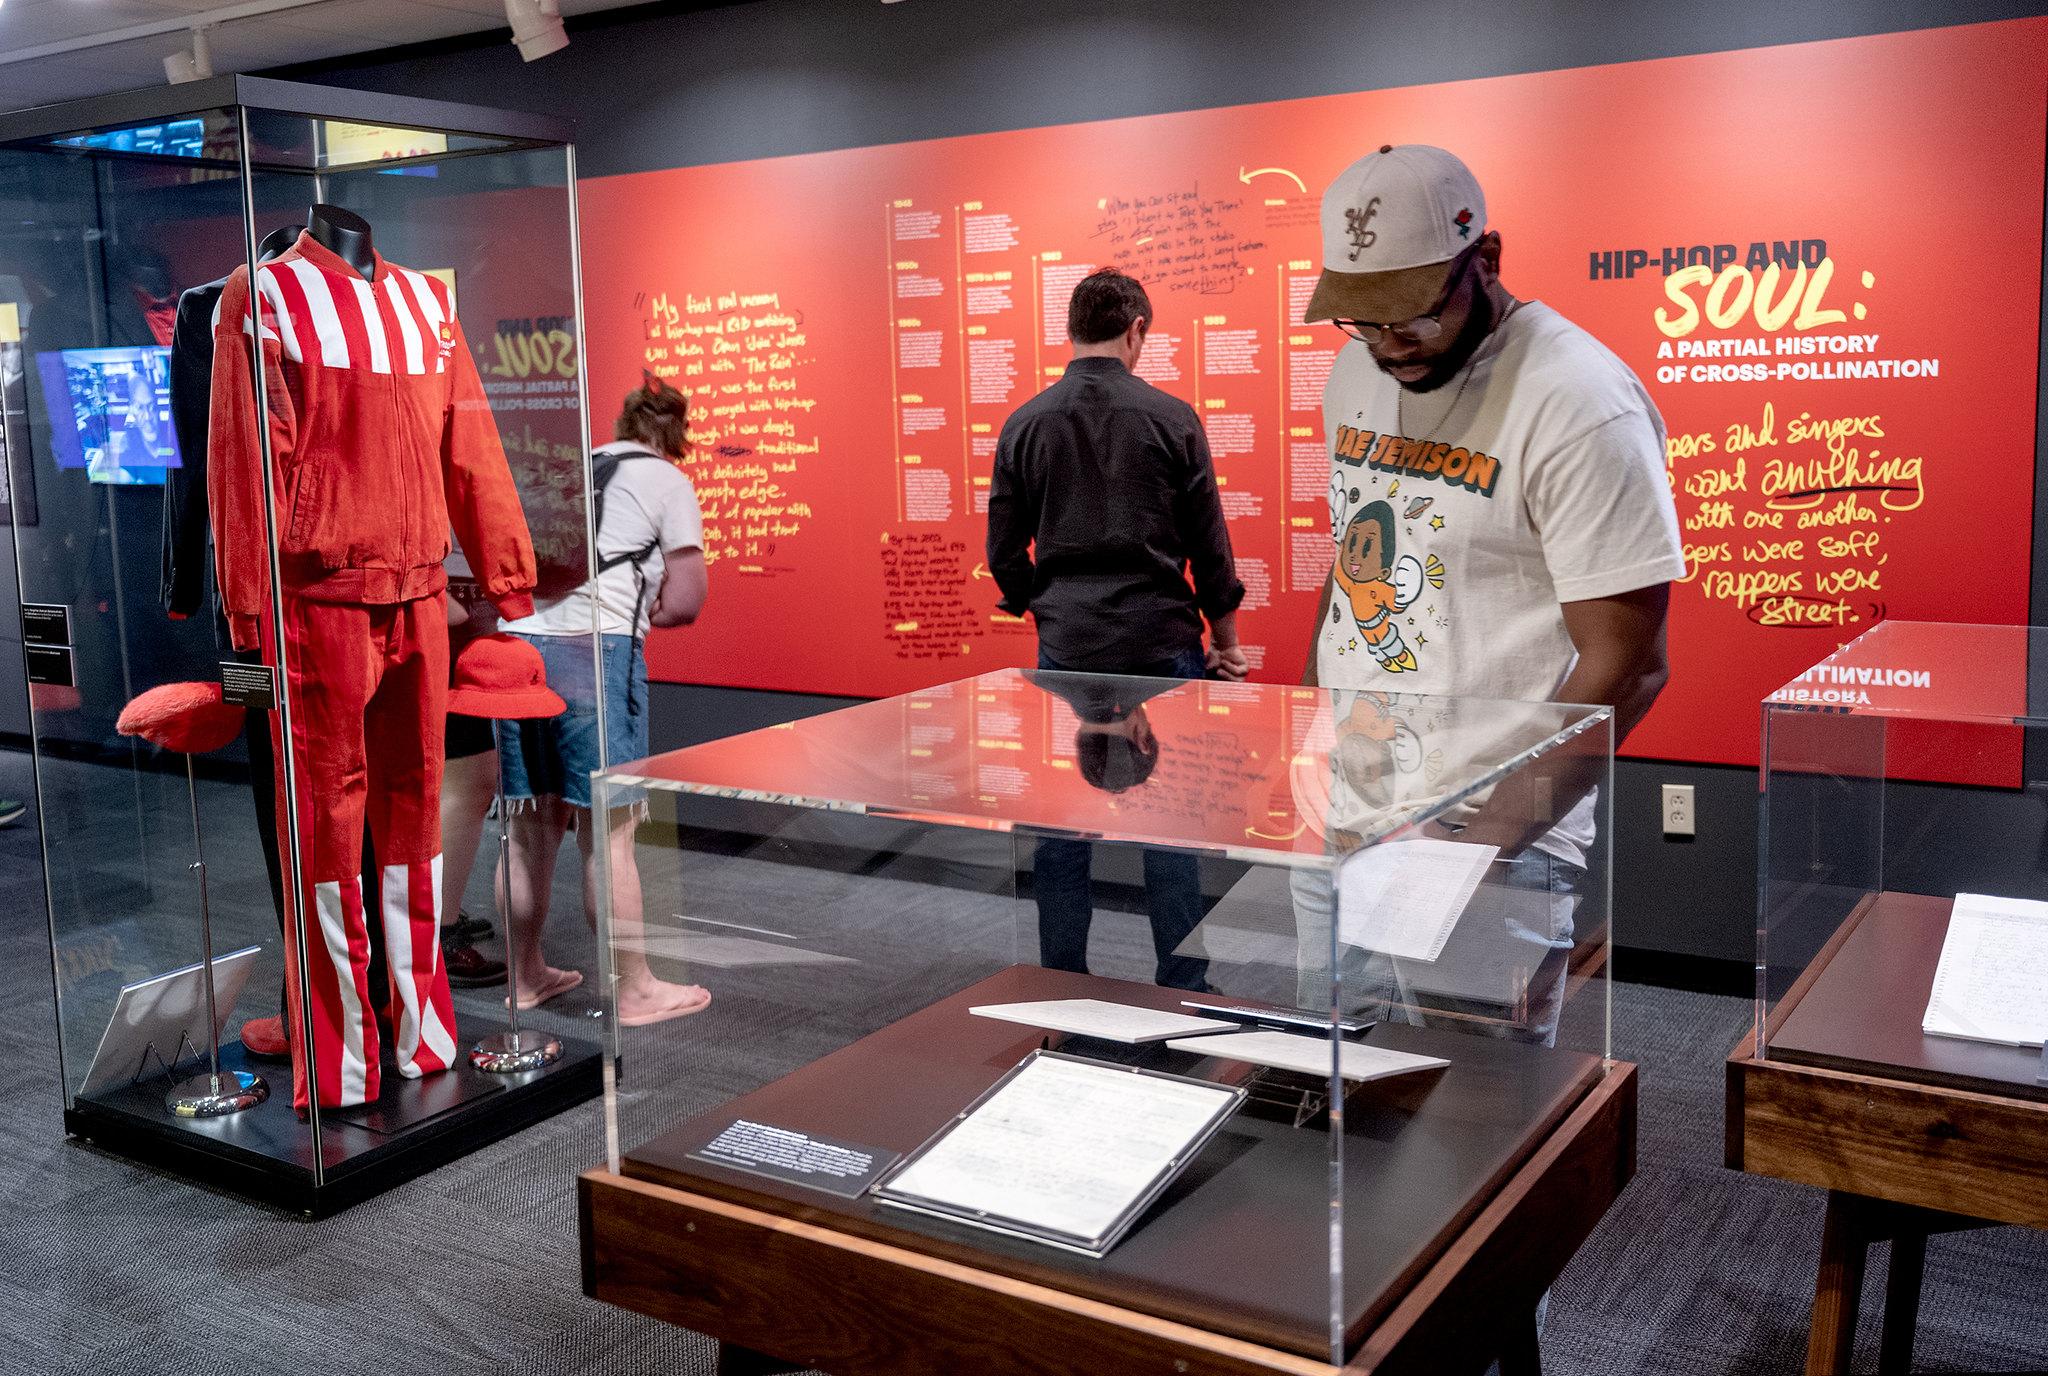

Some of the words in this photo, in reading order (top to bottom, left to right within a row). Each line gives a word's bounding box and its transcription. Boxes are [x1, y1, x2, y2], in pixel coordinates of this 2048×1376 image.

[1589, 244, 1737, 280] HIP-HOP
[1745, 239, 1827, 271] AND
[1654, 257, 1876, 338] SOUL:
[1657, 341, 1675, 359] A
[1677, 337, 1772, 359] PARTIAL
[1775, 334, 1880, 356] HISTORY
[1656, 364, 1688, 383] OF
[1690, 358, 1940, 382] CROSS-POLLINATION
[755, 436, 820, 456] traditional
[1666, 432, 1717, 468] pers
[1725, 402, 1778, 453] and
[1786, 411, 1886, 451] singers
[713, 463, 769, 483] definitely
[1369, 433, 1501, 498] JEMISON
[1684, 458, 1749, 499] want
[1761, 451, 1925, 512] anything
[1685, 502, 1735, 531] with
[1744, 510, 1784, 530] one
[1671, 541, 1733, 583] gers
[1743, 537, 1805, 563] were
[1701, 571, 1804, 609] rappers
[1815, 569, 1882, 595] were
